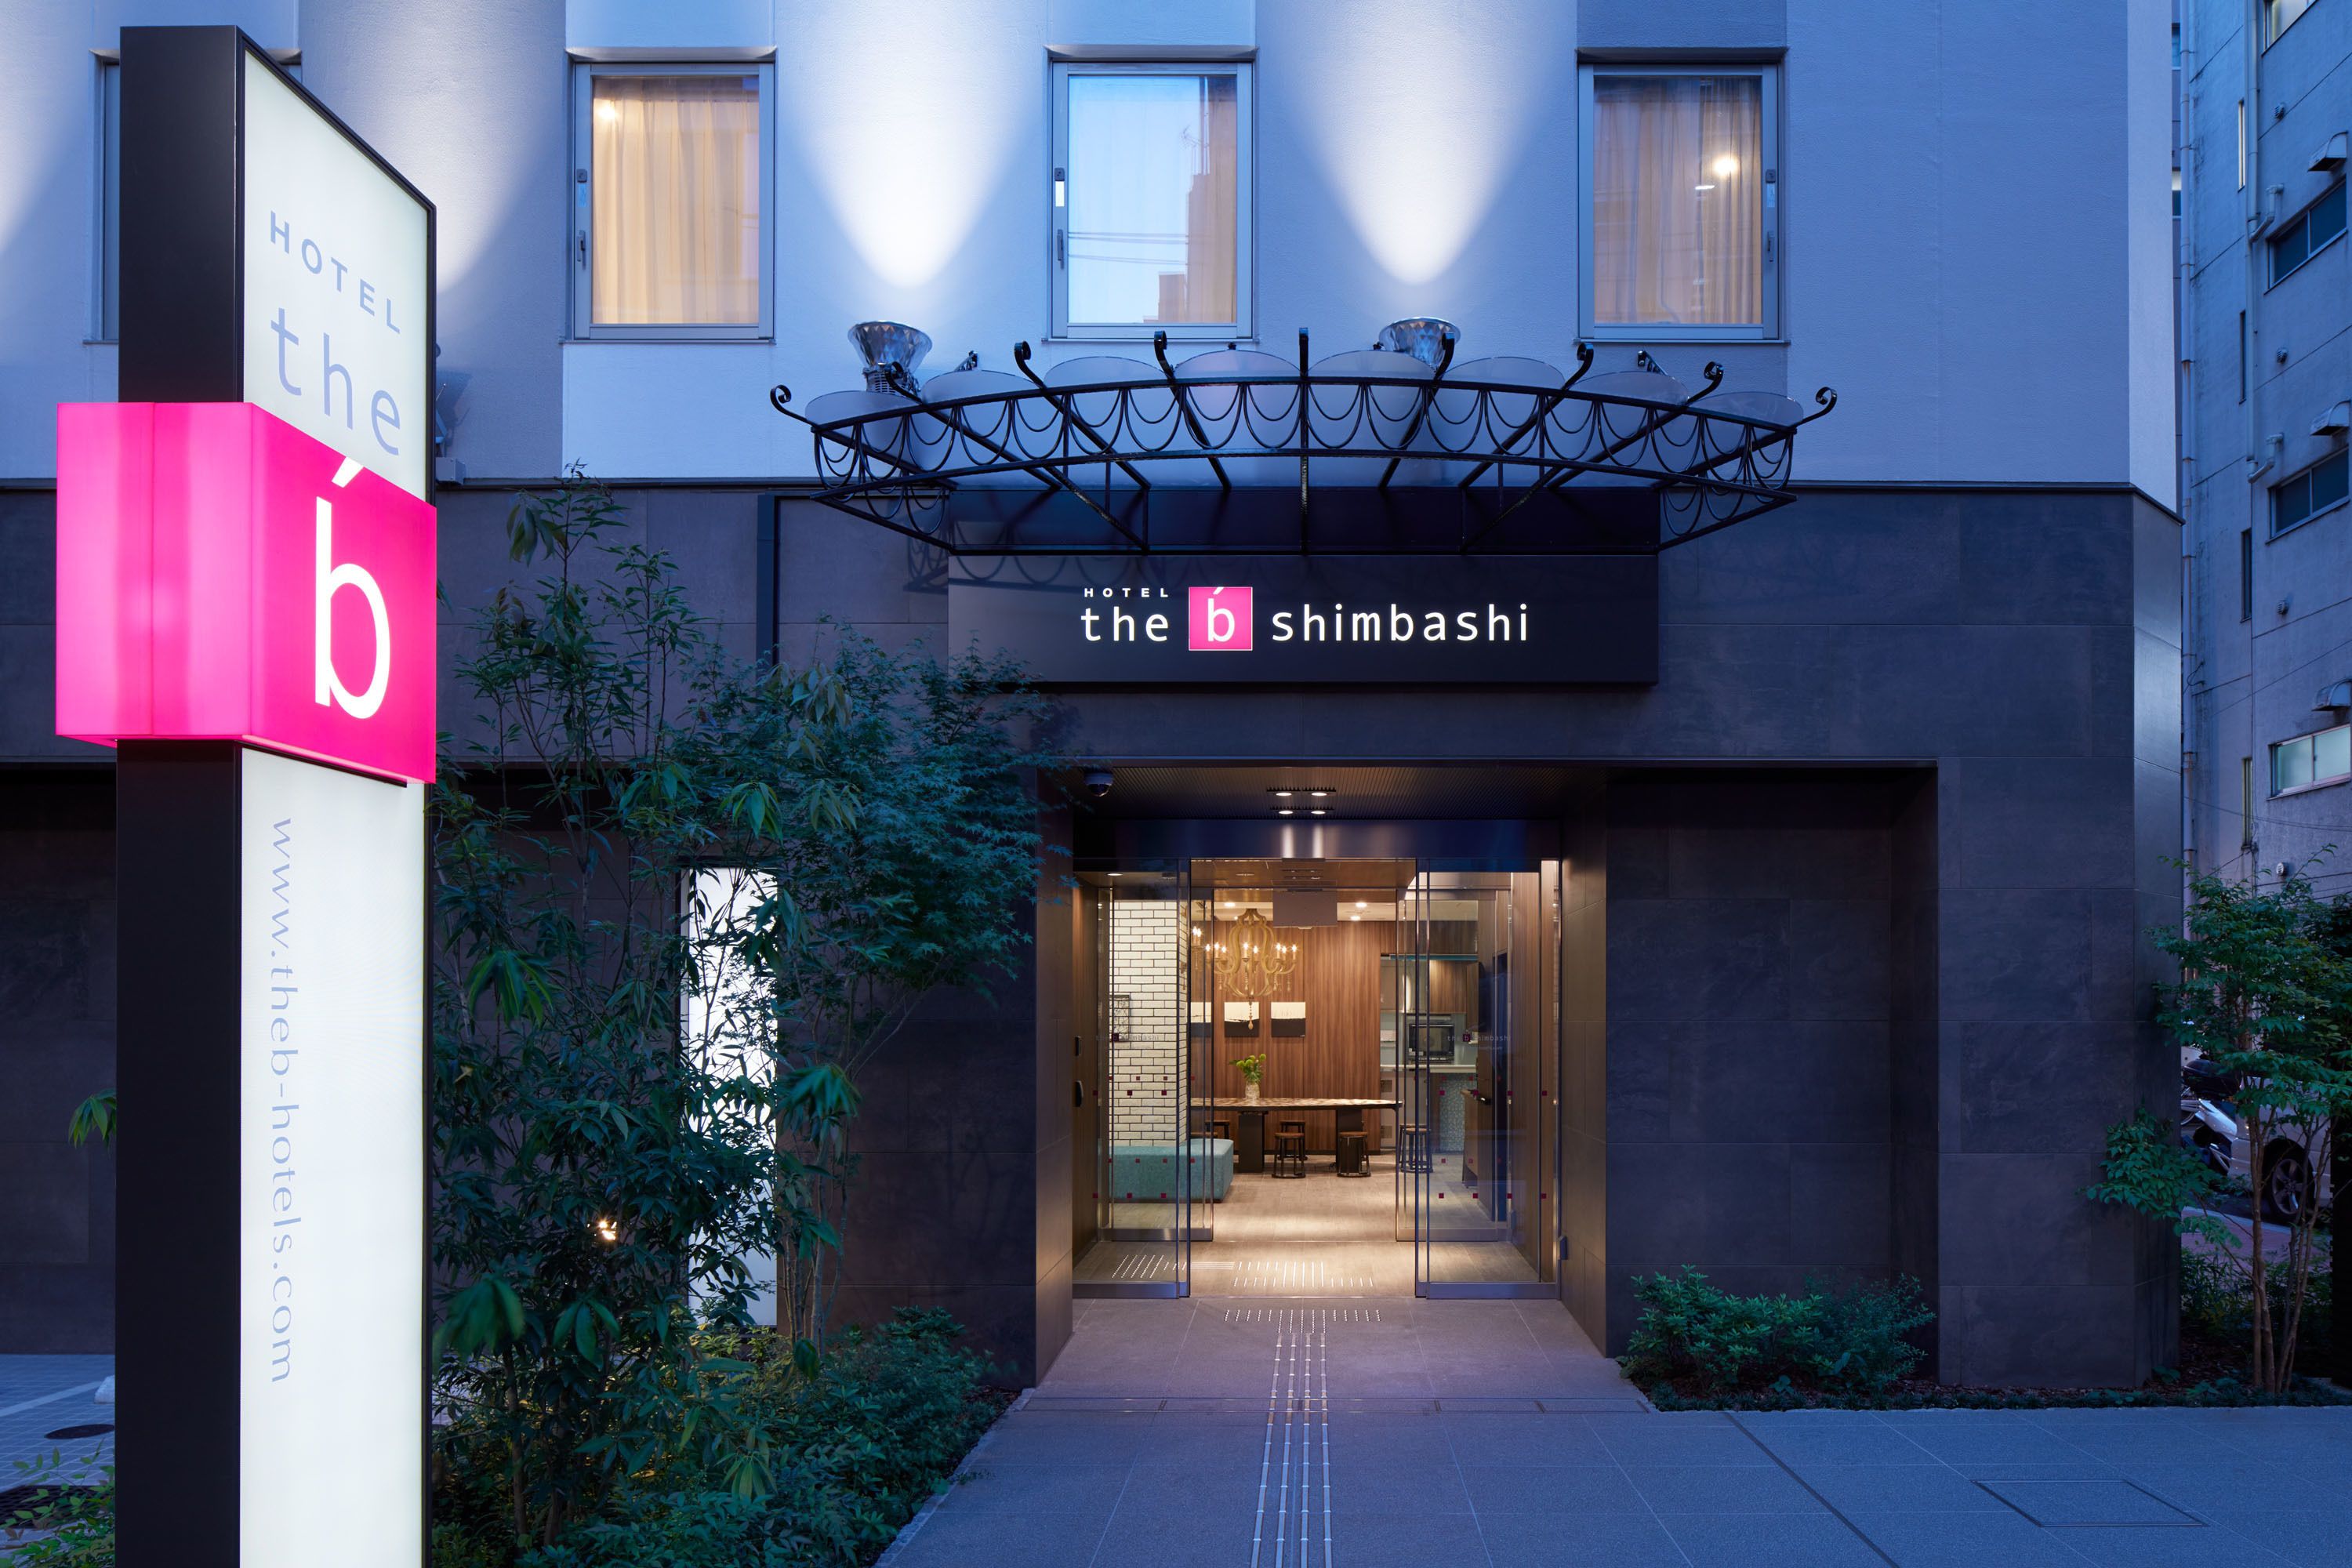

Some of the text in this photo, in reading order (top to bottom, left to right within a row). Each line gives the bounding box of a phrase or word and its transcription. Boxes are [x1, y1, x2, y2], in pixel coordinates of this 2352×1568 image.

[270, 210, 401, 335] HOTEL
[270, 307, 401, 456] the
[1080, 606, 1169, 641] the
[1272, 603, 1527, 641] shimbashi
[1083, 587, 1169, 598] HOTEL
[270, 818, 302, 1383] www.theb-hotels.com
